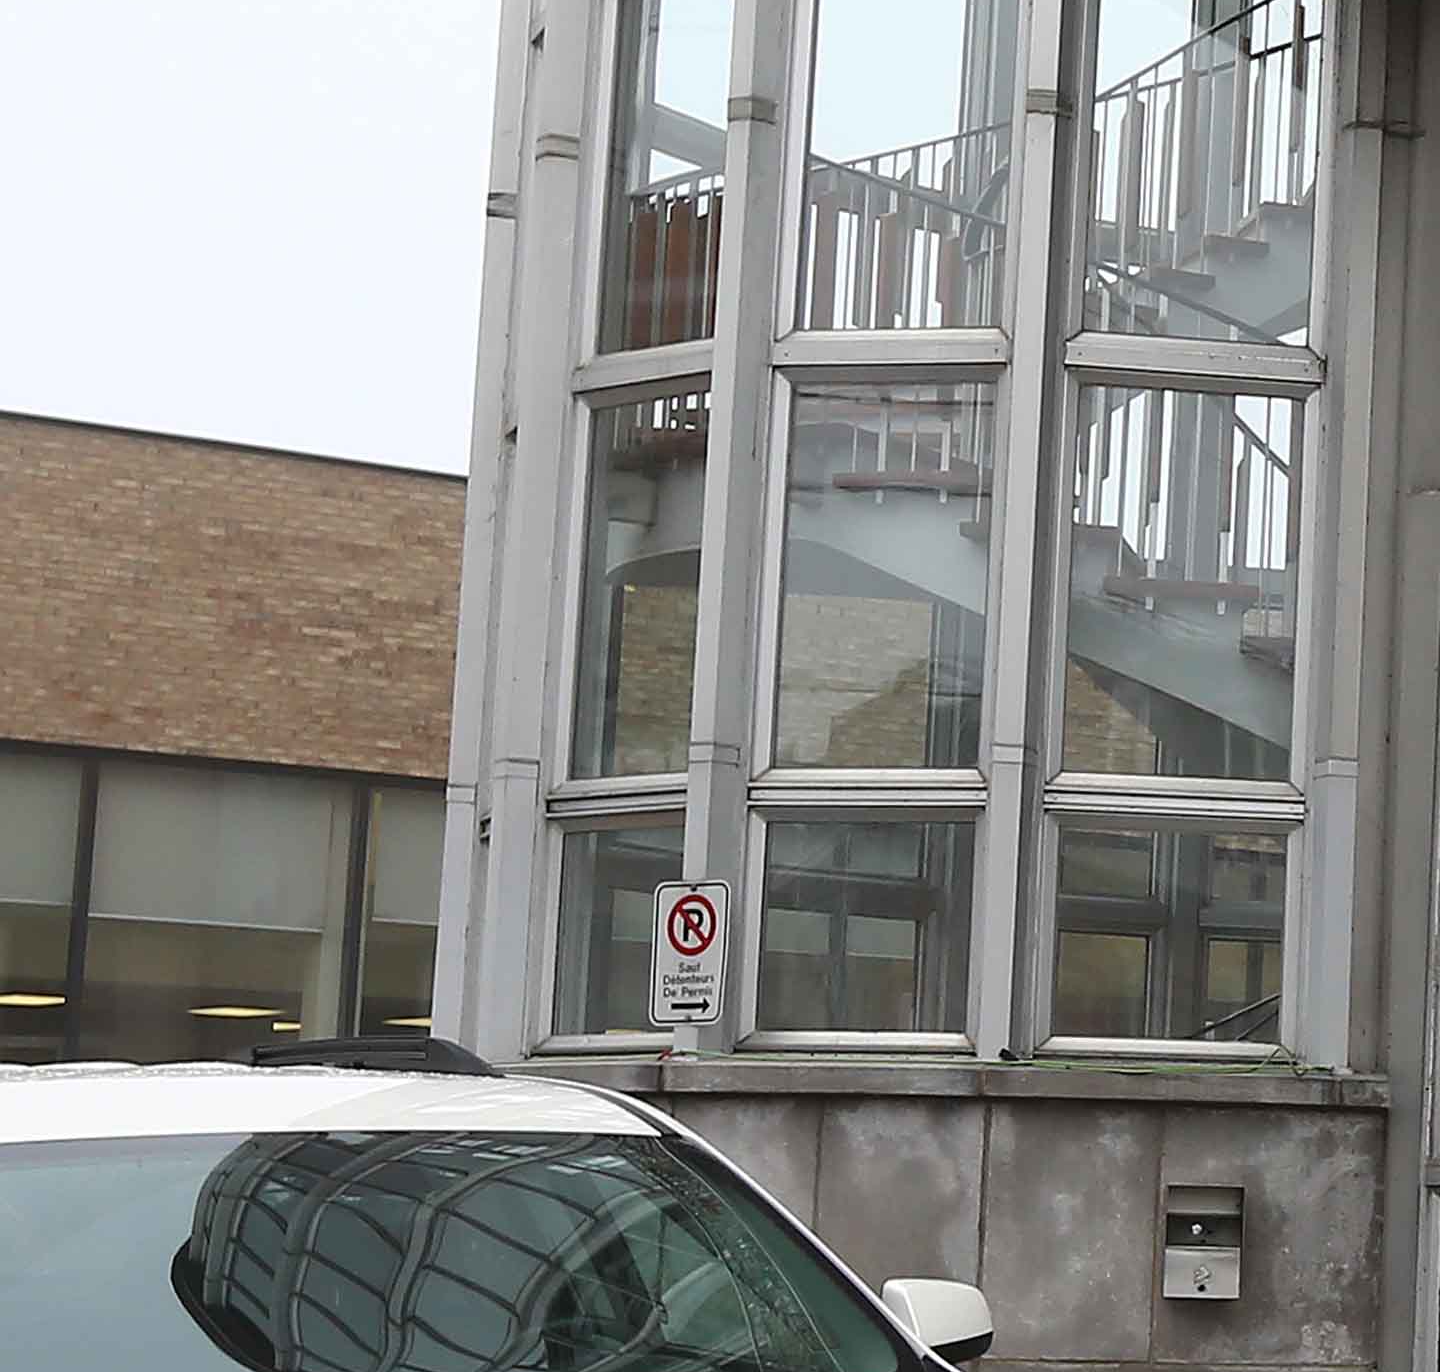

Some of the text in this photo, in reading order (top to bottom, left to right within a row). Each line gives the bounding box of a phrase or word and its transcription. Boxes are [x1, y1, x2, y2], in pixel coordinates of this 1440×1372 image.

[679, 962, 701, 973] Sauf
[663, 986, 713, 998] De Permis
